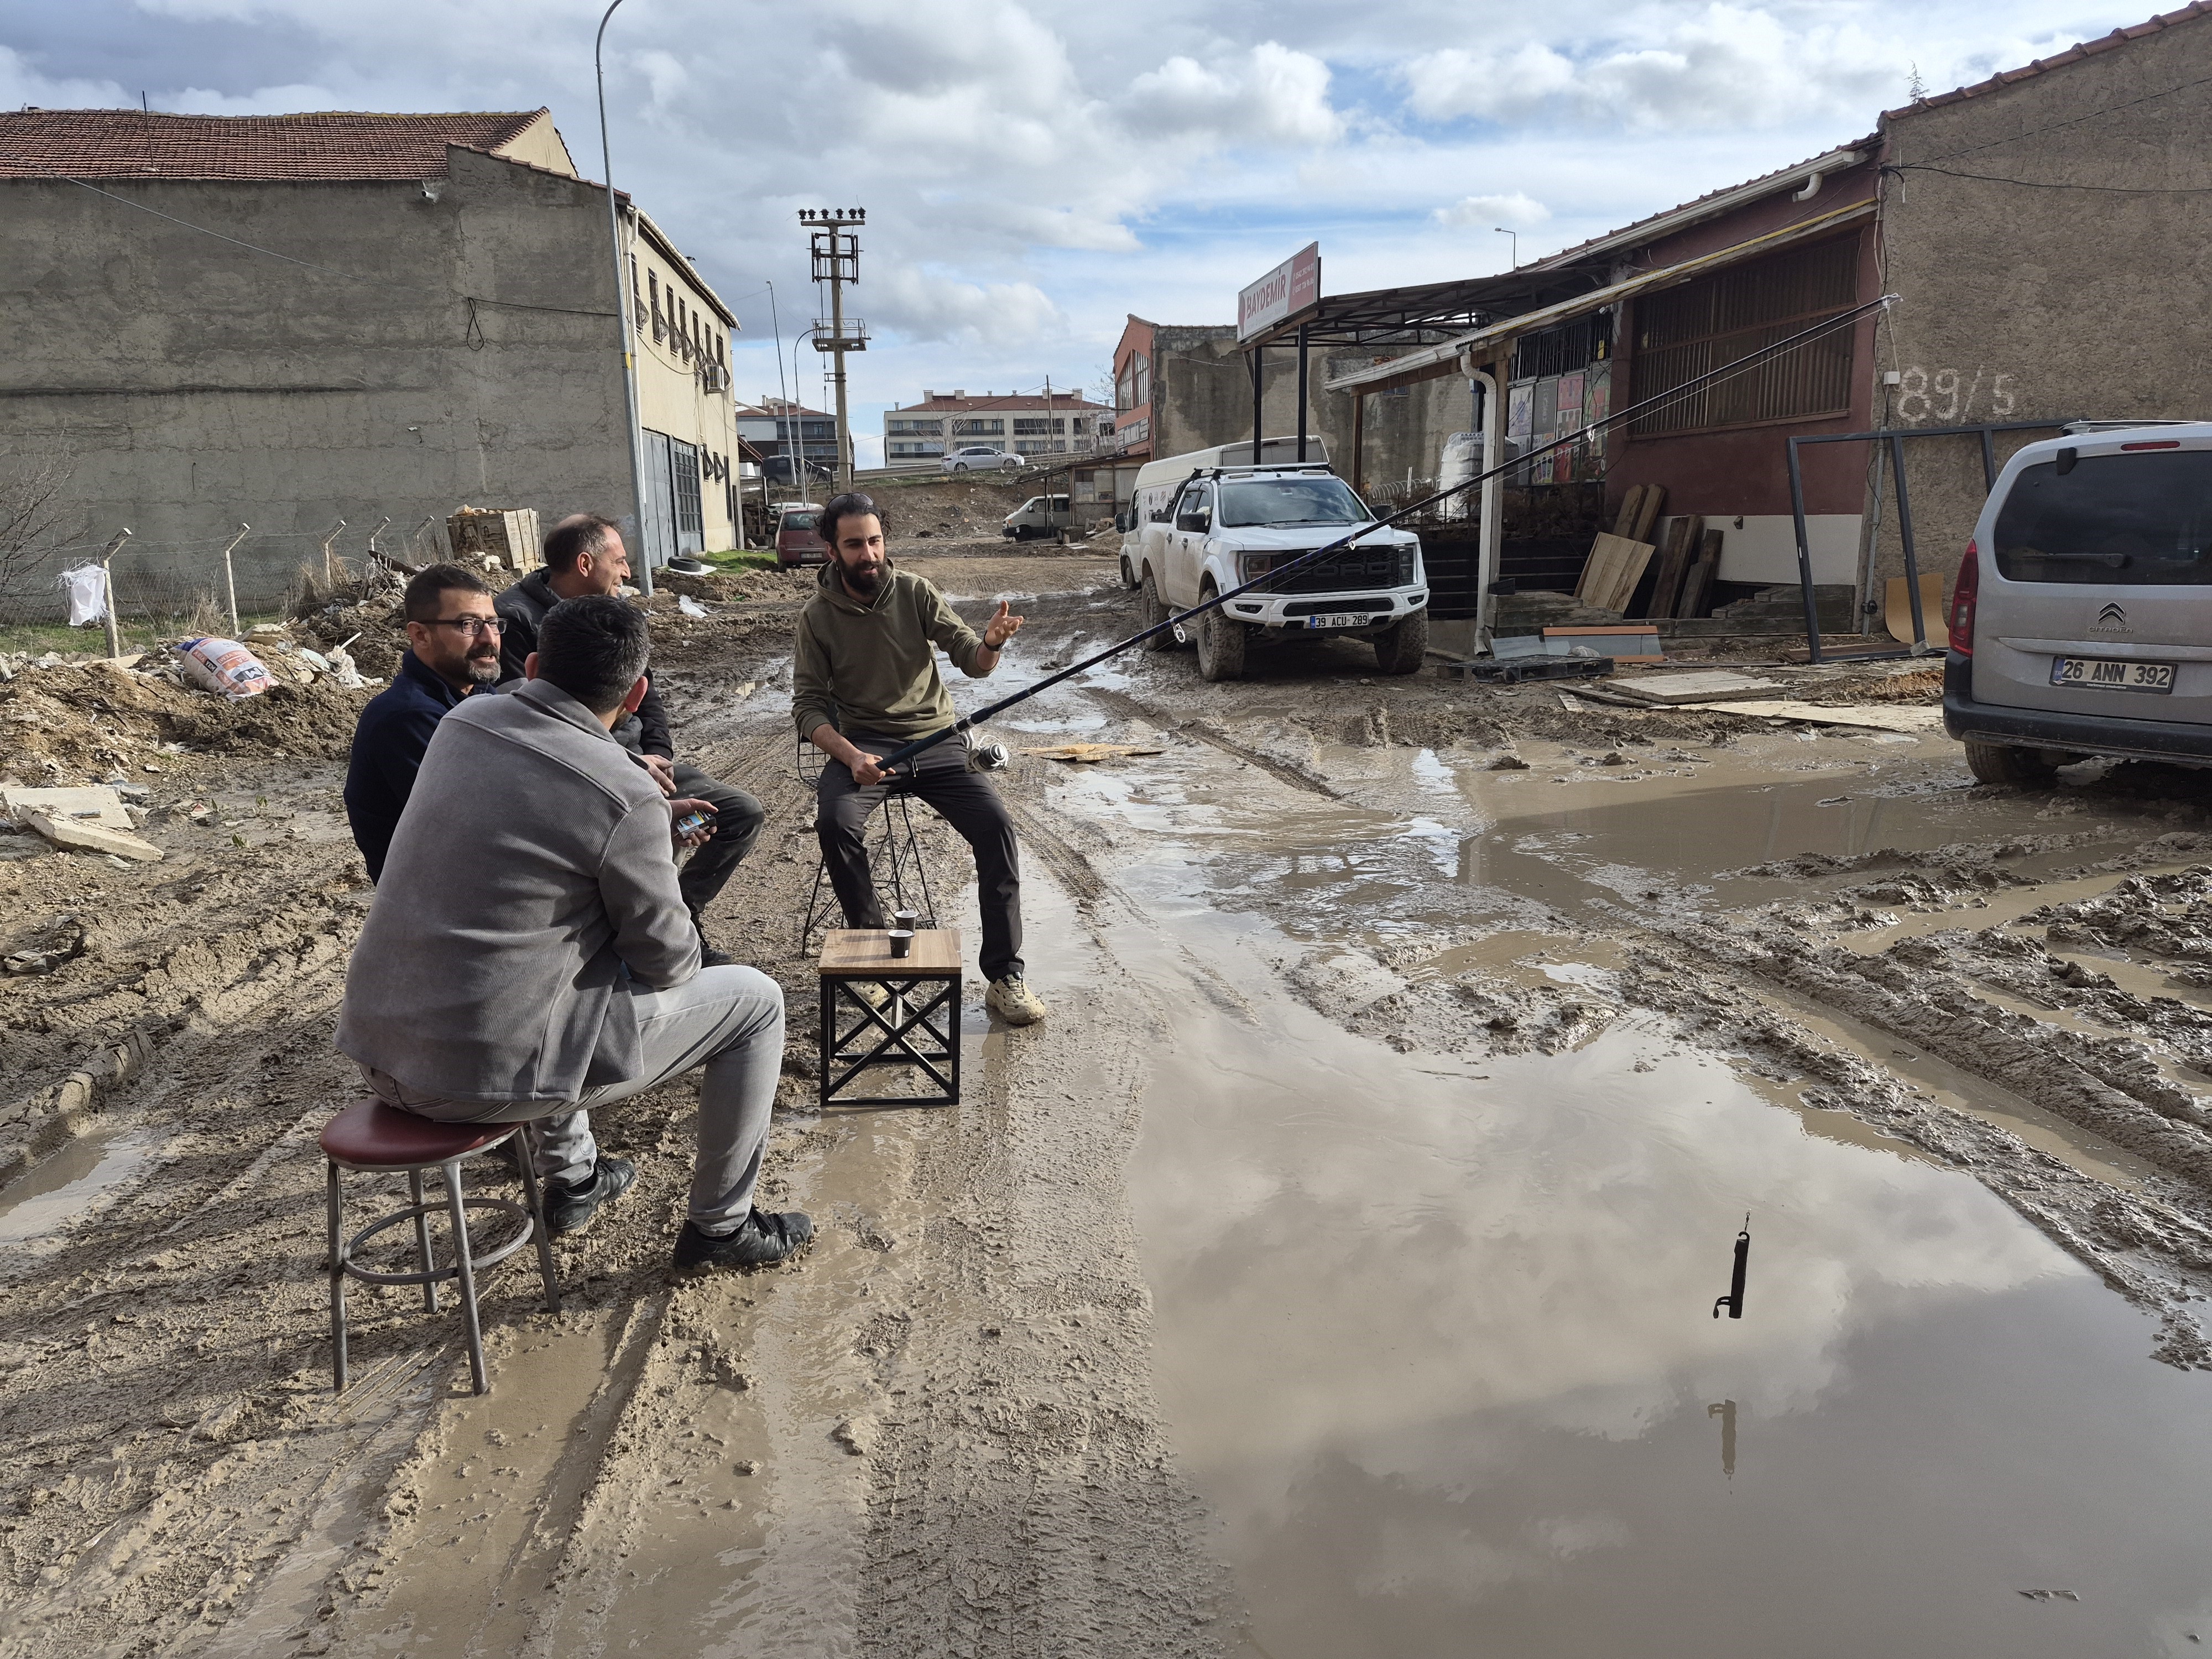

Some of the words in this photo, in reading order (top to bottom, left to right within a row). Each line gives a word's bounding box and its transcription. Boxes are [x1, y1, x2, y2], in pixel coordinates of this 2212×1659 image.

[1247, 268, 1286, 319] BAYDEMİR
[1897, 364, 2016, 424] 89/5
[1316, 617, 1326, 627] 39
[1331, 616, 1347, 627] ACU
[1352, 615, 1368, 625] 289
[2062, 661, 2084, 679] 26
[2091, 662, 2126, 682] ANN
[2133, 666, 2170, 686] 392
